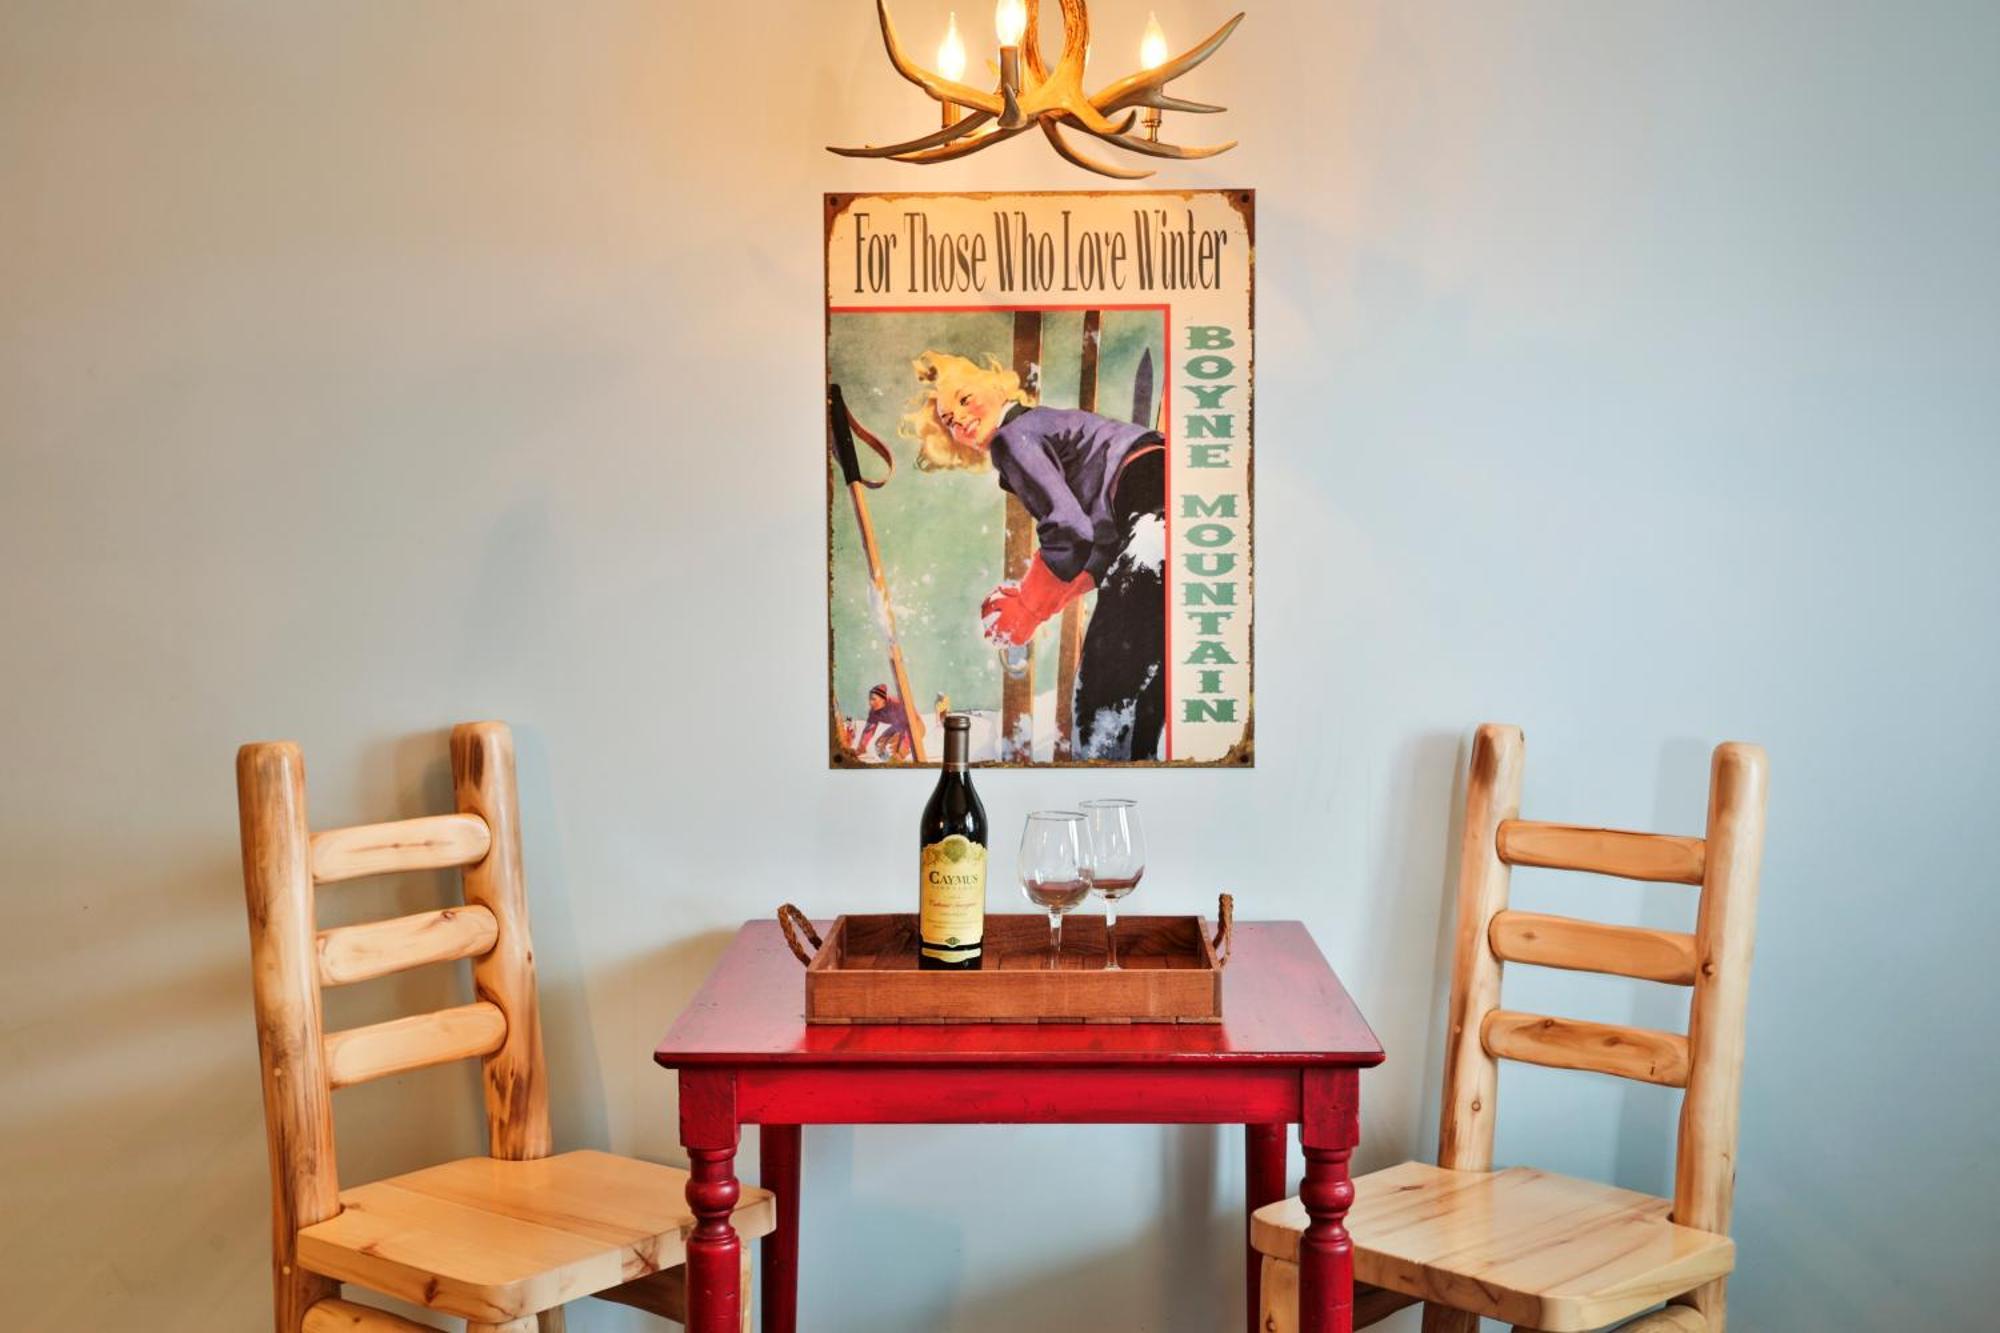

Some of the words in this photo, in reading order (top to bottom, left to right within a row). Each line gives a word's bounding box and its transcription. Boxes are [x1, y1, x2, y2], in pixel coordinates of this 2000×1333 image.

[853, 212, 897, 293] For
[903, 211, 987, 293] Those
[993, 210, 1055, 292] Who
[1061, 209, 1127, 291] Love
[1134, 208, 1228, 291] Winter
[1183, 325, 1237, 468] BOYNE
[1180, 494, 1240, 723] MOUNTAIN
